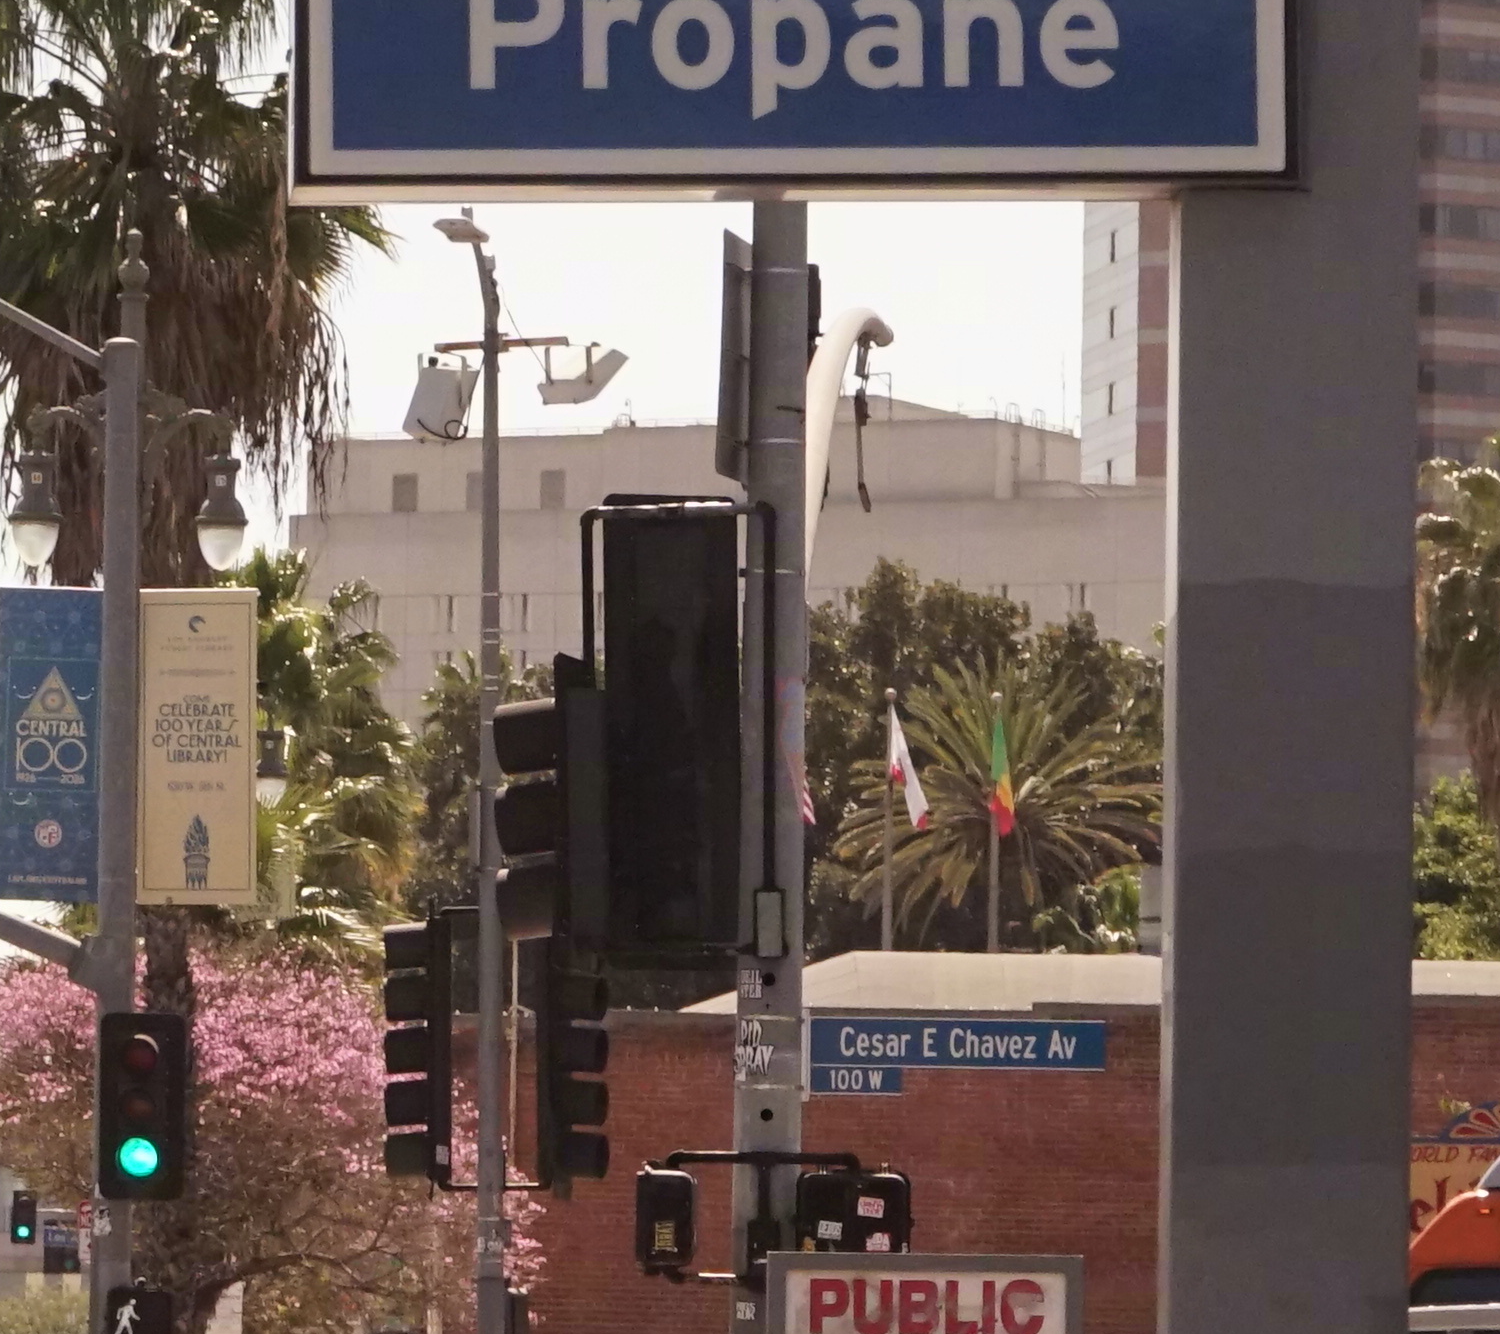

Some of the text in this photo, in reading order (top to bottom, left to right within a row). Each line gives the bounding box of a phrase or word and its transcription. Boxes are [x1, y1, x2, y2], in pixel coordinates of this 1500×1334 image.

[159, 703, 236, 718] CELEBRATE
[15, 718, 88, 738] CENTRAL
[155, 718, 240, 733] 100 YEARS
[151, 734, 243, 749] OF CENTRAL
[14, 736, 89, 774] 100
[166, 748, 229, 764] LIBRARY!
[839, 1026, 1077, 1060] Cesar E Chavez Av
[829, 1069, 884, 1091] 100 W
[1411, 1145, 1460, 1164] ORLD
